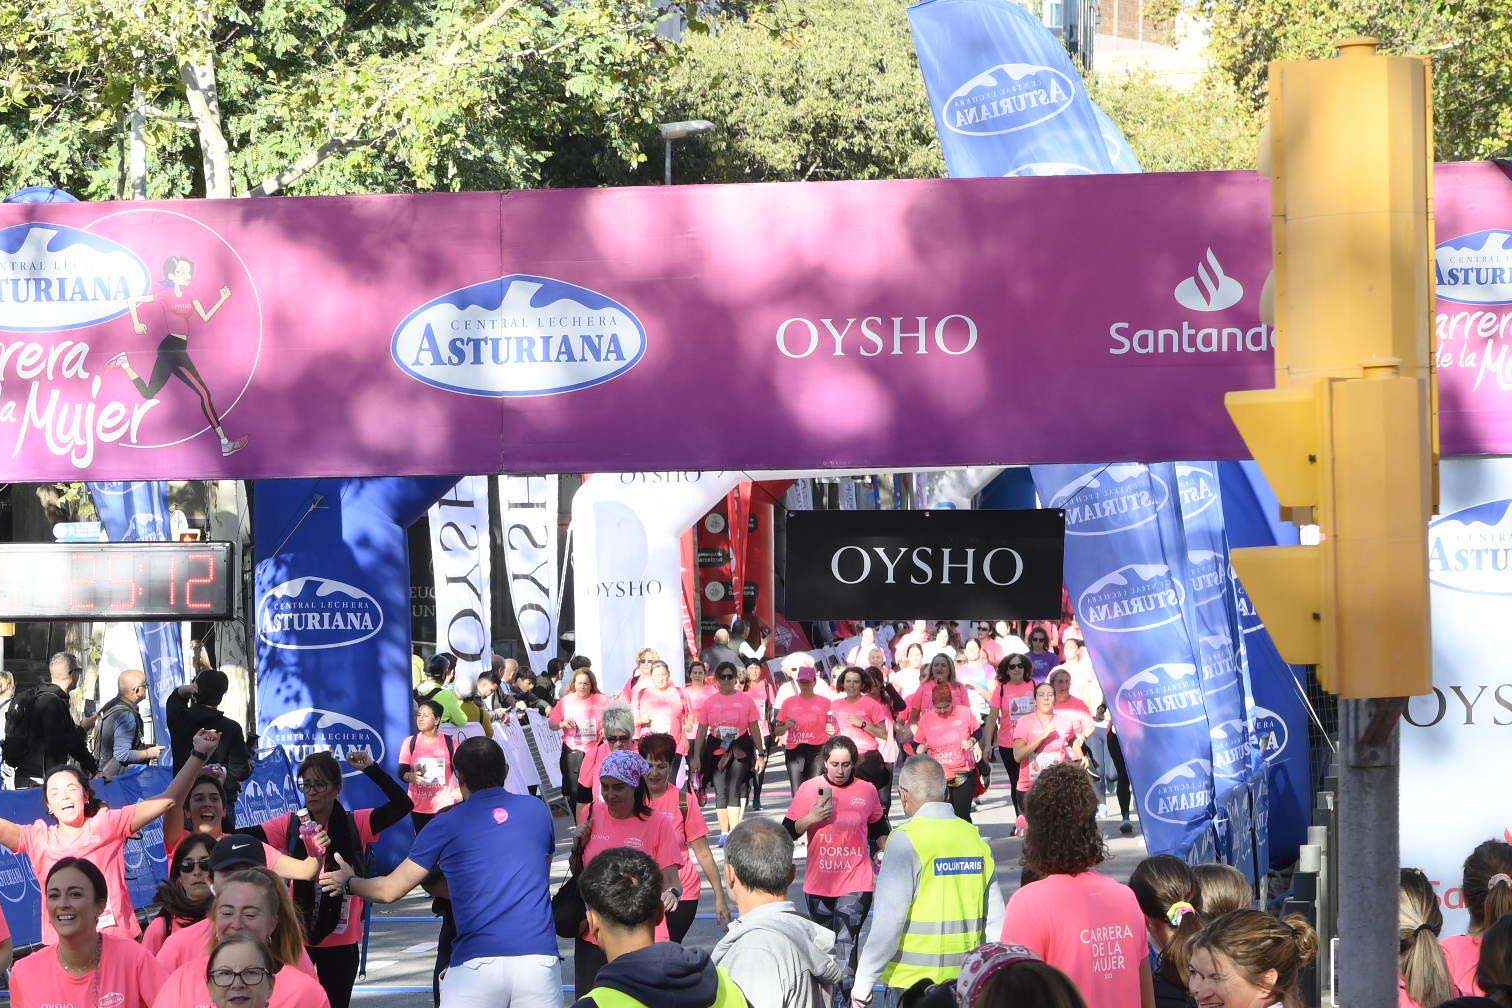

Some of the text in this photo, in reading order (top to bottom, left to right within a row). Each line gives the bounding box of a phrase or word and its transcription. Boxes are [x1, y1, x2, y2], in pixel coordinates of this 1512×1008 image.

[449, 315, 618, 331] CENTRAL LECHERA
[410, 323, 627, 368] ASTURIANA
[775, 314, 979, 359] OYSHO
[1108, 322, 1275, 356] Santand
[1458, 348, 1477, 369] la
[11, 374, 161, 468] Mujer
[830, 544, 1025, 586] OYSHO
[273, 600, 370, 611] CENTRAL LECHERA
[262, 605, 374, 633] ASTURIANA
[320, 730, 371, 742] LECHERA
[819, 833, 832, 842] TU
[819, 846, 863, 857] DORSAL
[819, 859, 852, 870] SUMA
[935, 861, 982, 872] VOLUNTARIS
[1079, 924, 1134, 944] CARRERA
[1092, 941, 1123, 958] DE LA
[1093, 955, 1126, 974] MUJER
